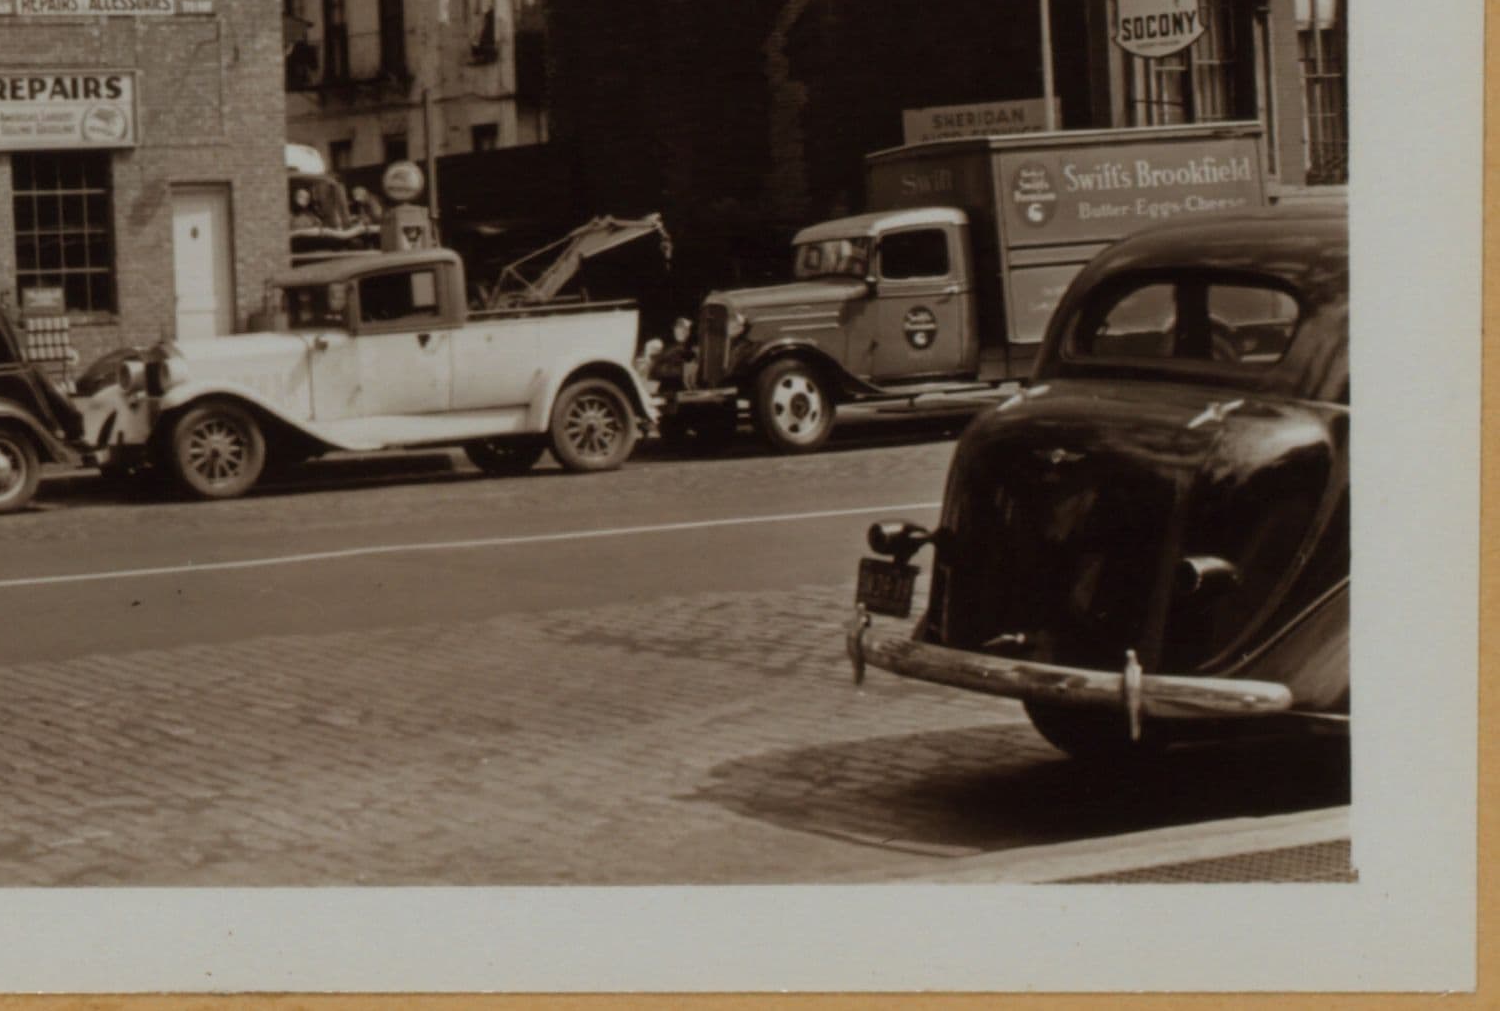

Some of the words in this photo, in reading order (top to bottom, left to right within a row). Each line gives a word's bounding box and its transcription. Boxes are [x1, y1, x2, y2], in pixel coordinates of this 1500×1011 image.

[1121, 10, 1196, 42] SOCONY
[931, 107, 1025, 129] SHERIDAN
[1064, 160, 1132, 192] Swift's
[1135, 155, 1252, 188] Brookfield
